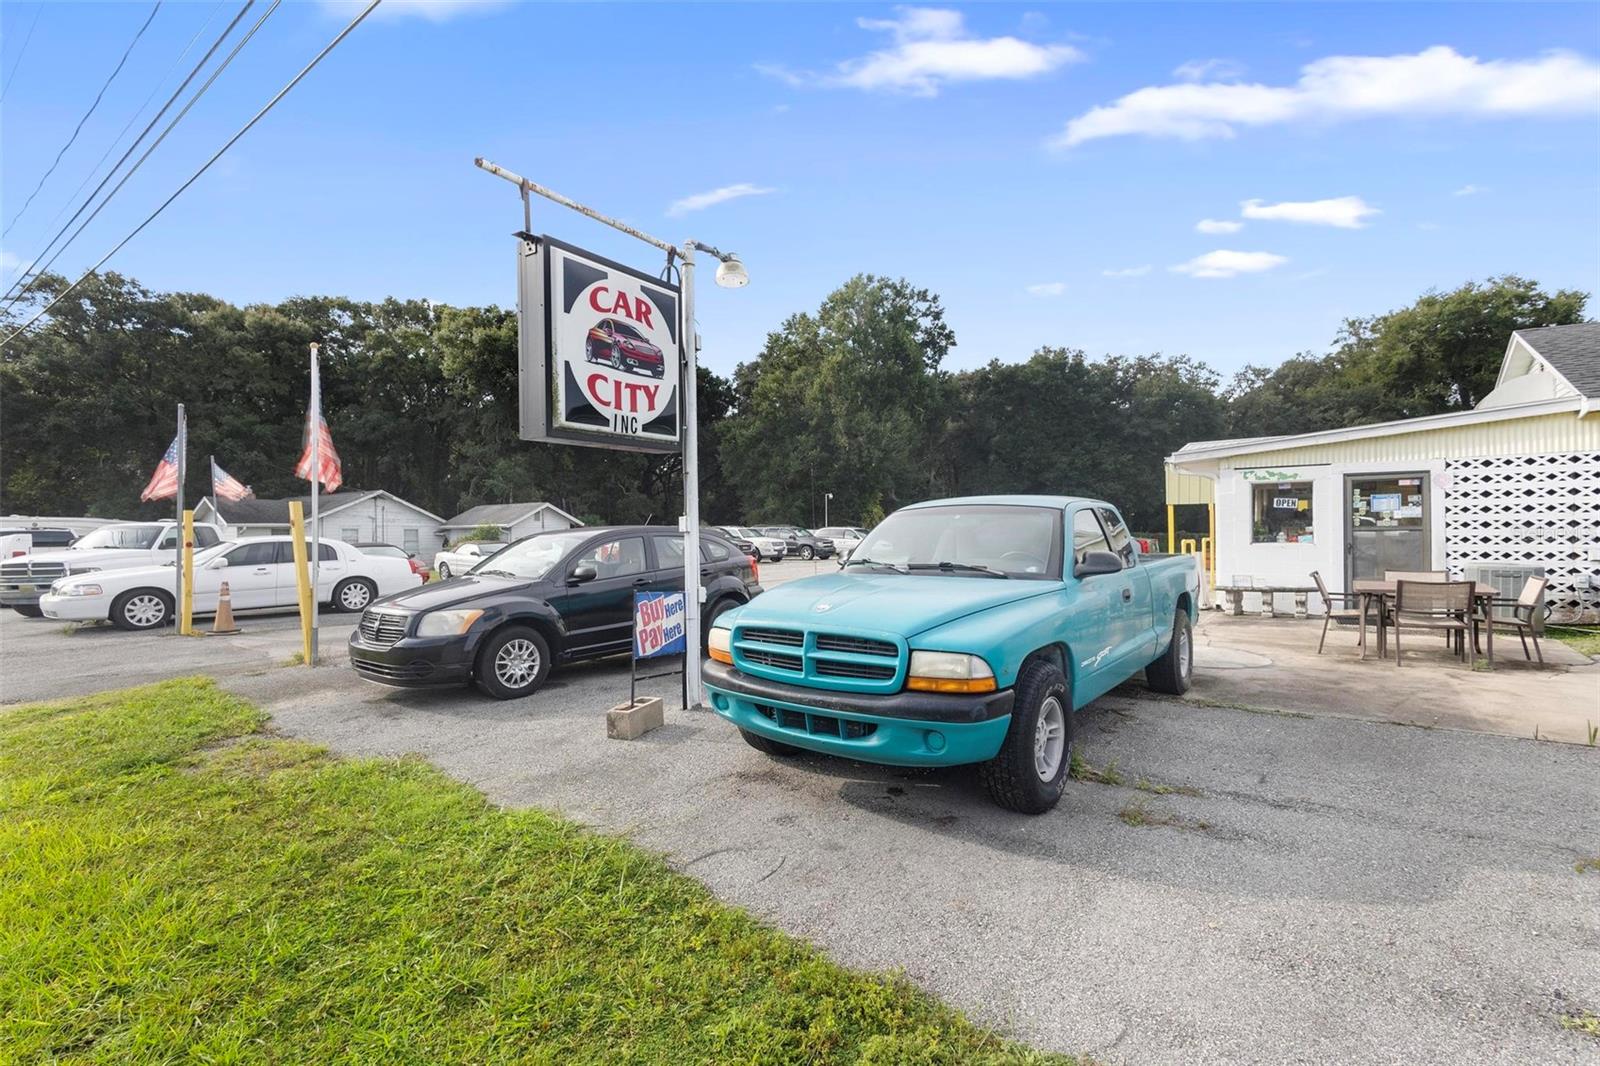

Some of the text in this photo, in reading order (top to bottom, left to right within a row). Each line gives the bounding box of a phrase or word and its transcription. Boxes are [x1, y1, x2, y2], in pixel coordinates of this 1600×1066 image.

[589, 286, 654, 330] CAR
[587, 373, 660, 413] CITY
[613, 413, 638, 434] INC
[1276, 499, 1296, 507] OPEN
[639, 598, 683, 627] Buy Here
[639, 623, 682, 654] Pay Here
